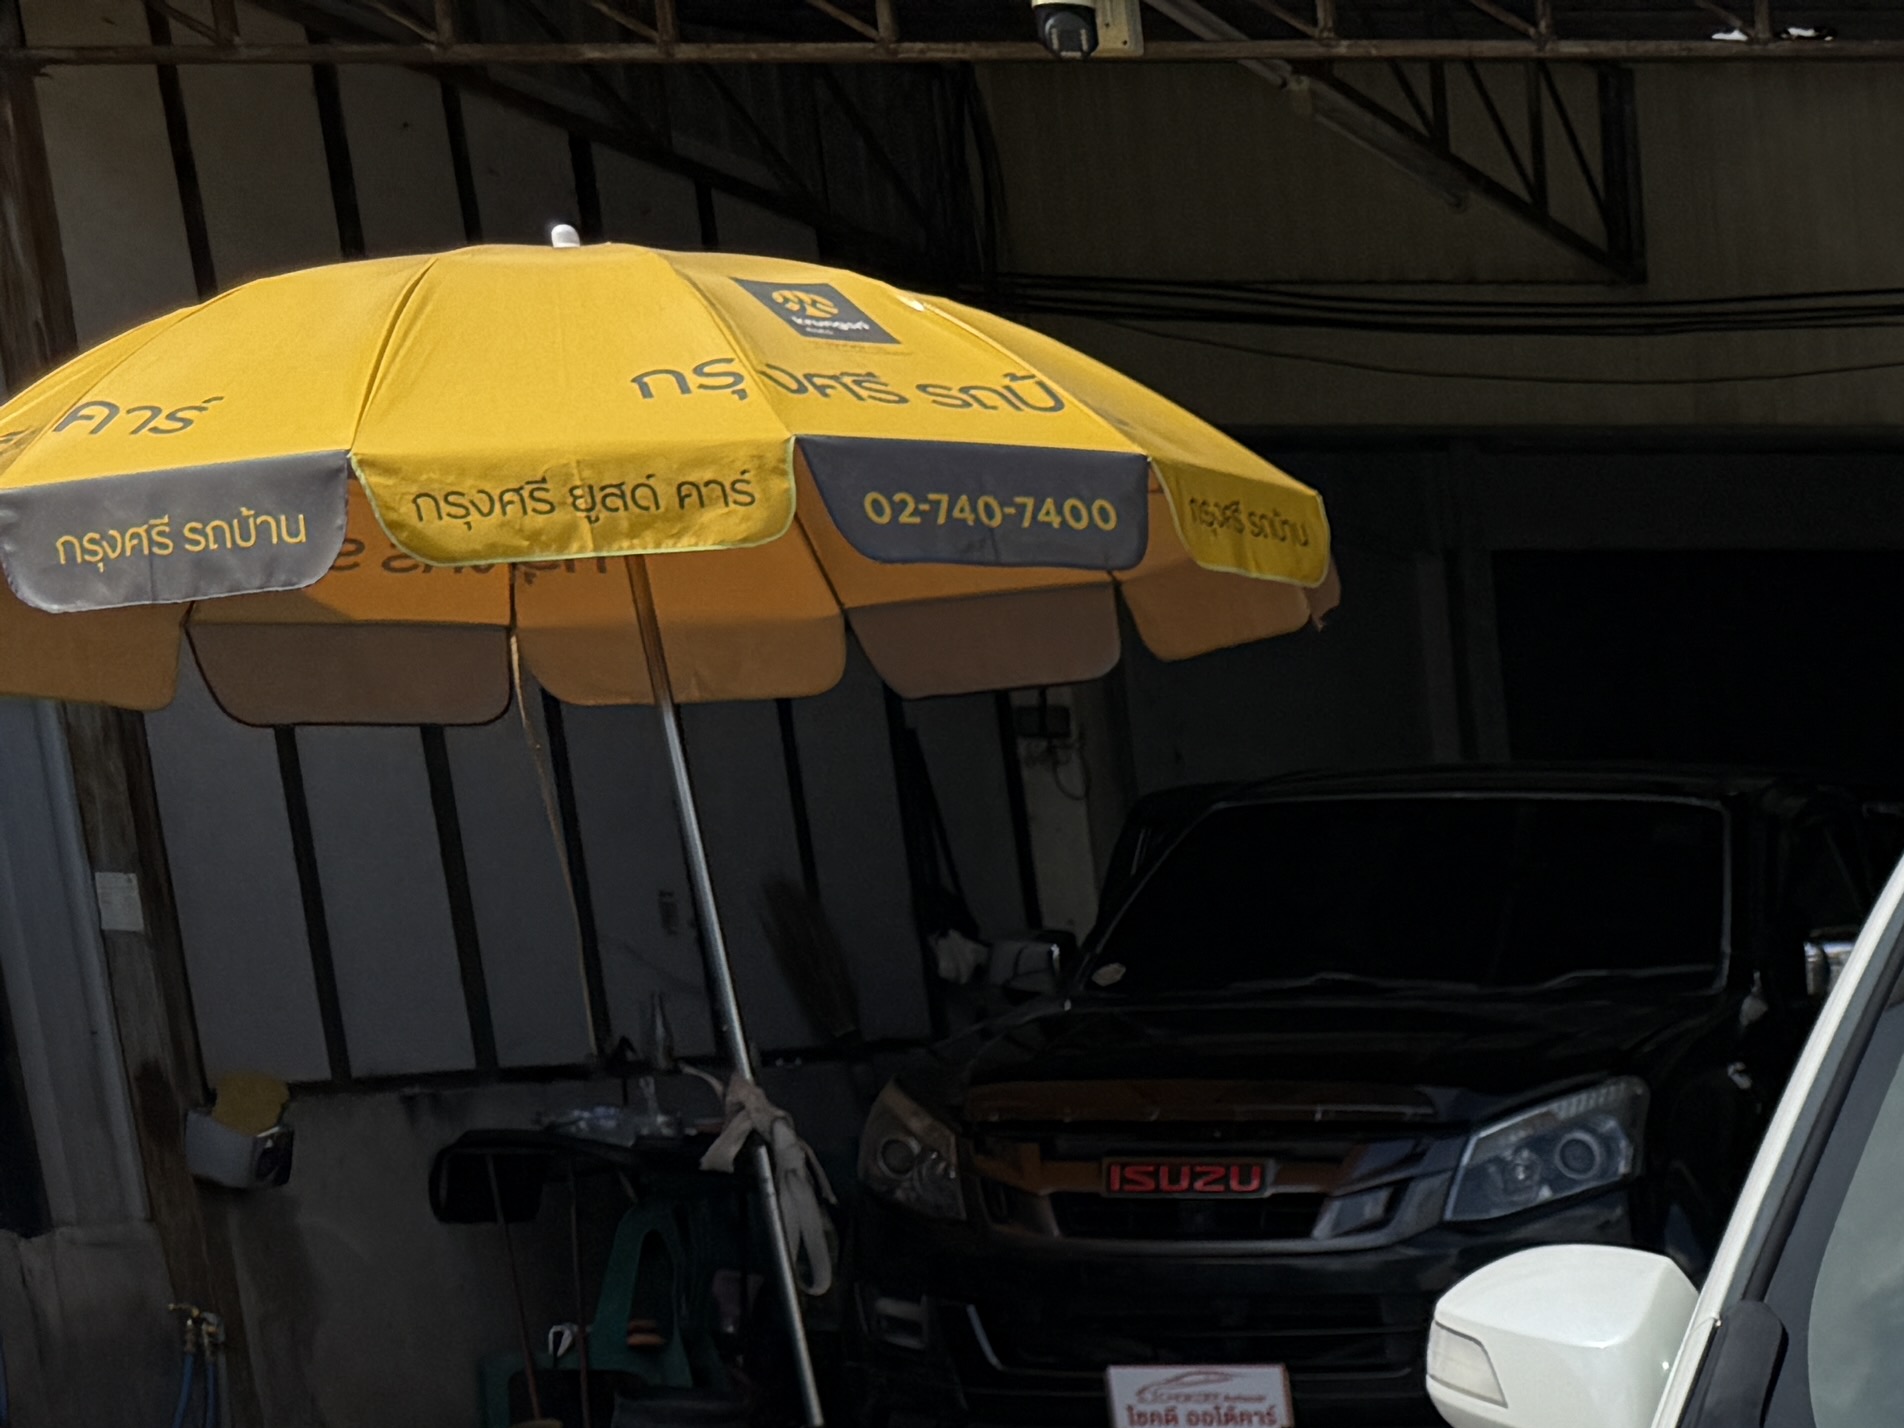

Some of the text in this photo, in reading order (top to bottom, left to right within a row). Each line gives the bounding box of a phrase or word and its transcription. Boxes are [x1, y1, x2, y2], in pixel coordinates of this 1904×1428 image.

[630, 357, 1067, 413] กรุงศรี รถบ้
[52, 396, 224, 435] คาร์
[412, 470, 756, 531] กรุงศรี ยูสด์ คาร์
[864, 491, 1118, 532] 02-740-7400
[55, 506, 306, 573] กรุงศรี รถบ้าน
[1110, 1164, 1262, 1193] ISUZU
